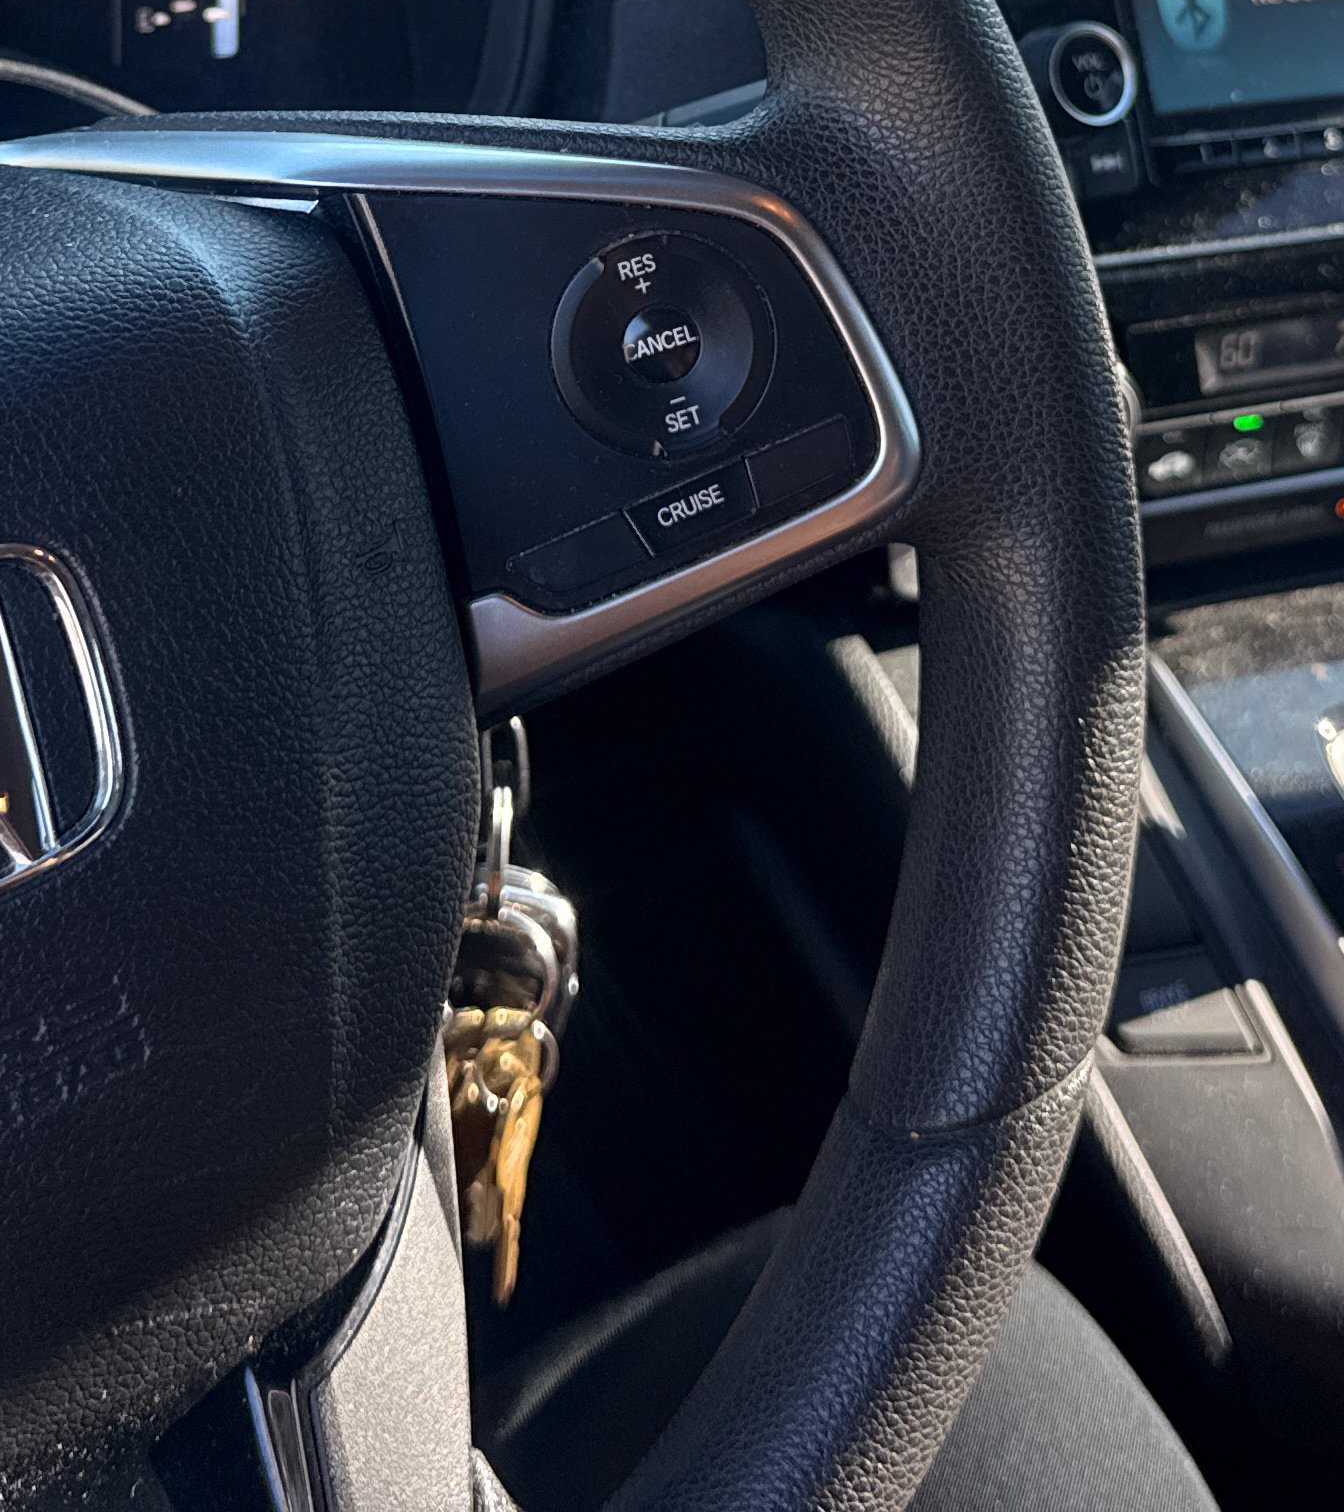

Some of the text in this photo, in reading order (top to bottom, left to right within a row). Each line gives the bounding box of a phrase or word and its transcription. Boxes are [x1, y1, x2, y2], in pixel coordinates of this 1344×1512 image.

[617, 253, 657, 281] RES
[623, 324, 698, 364] CANCEL
[664, 405, 701, 434] SET
[656, 484, 725, 528] CRUISE
